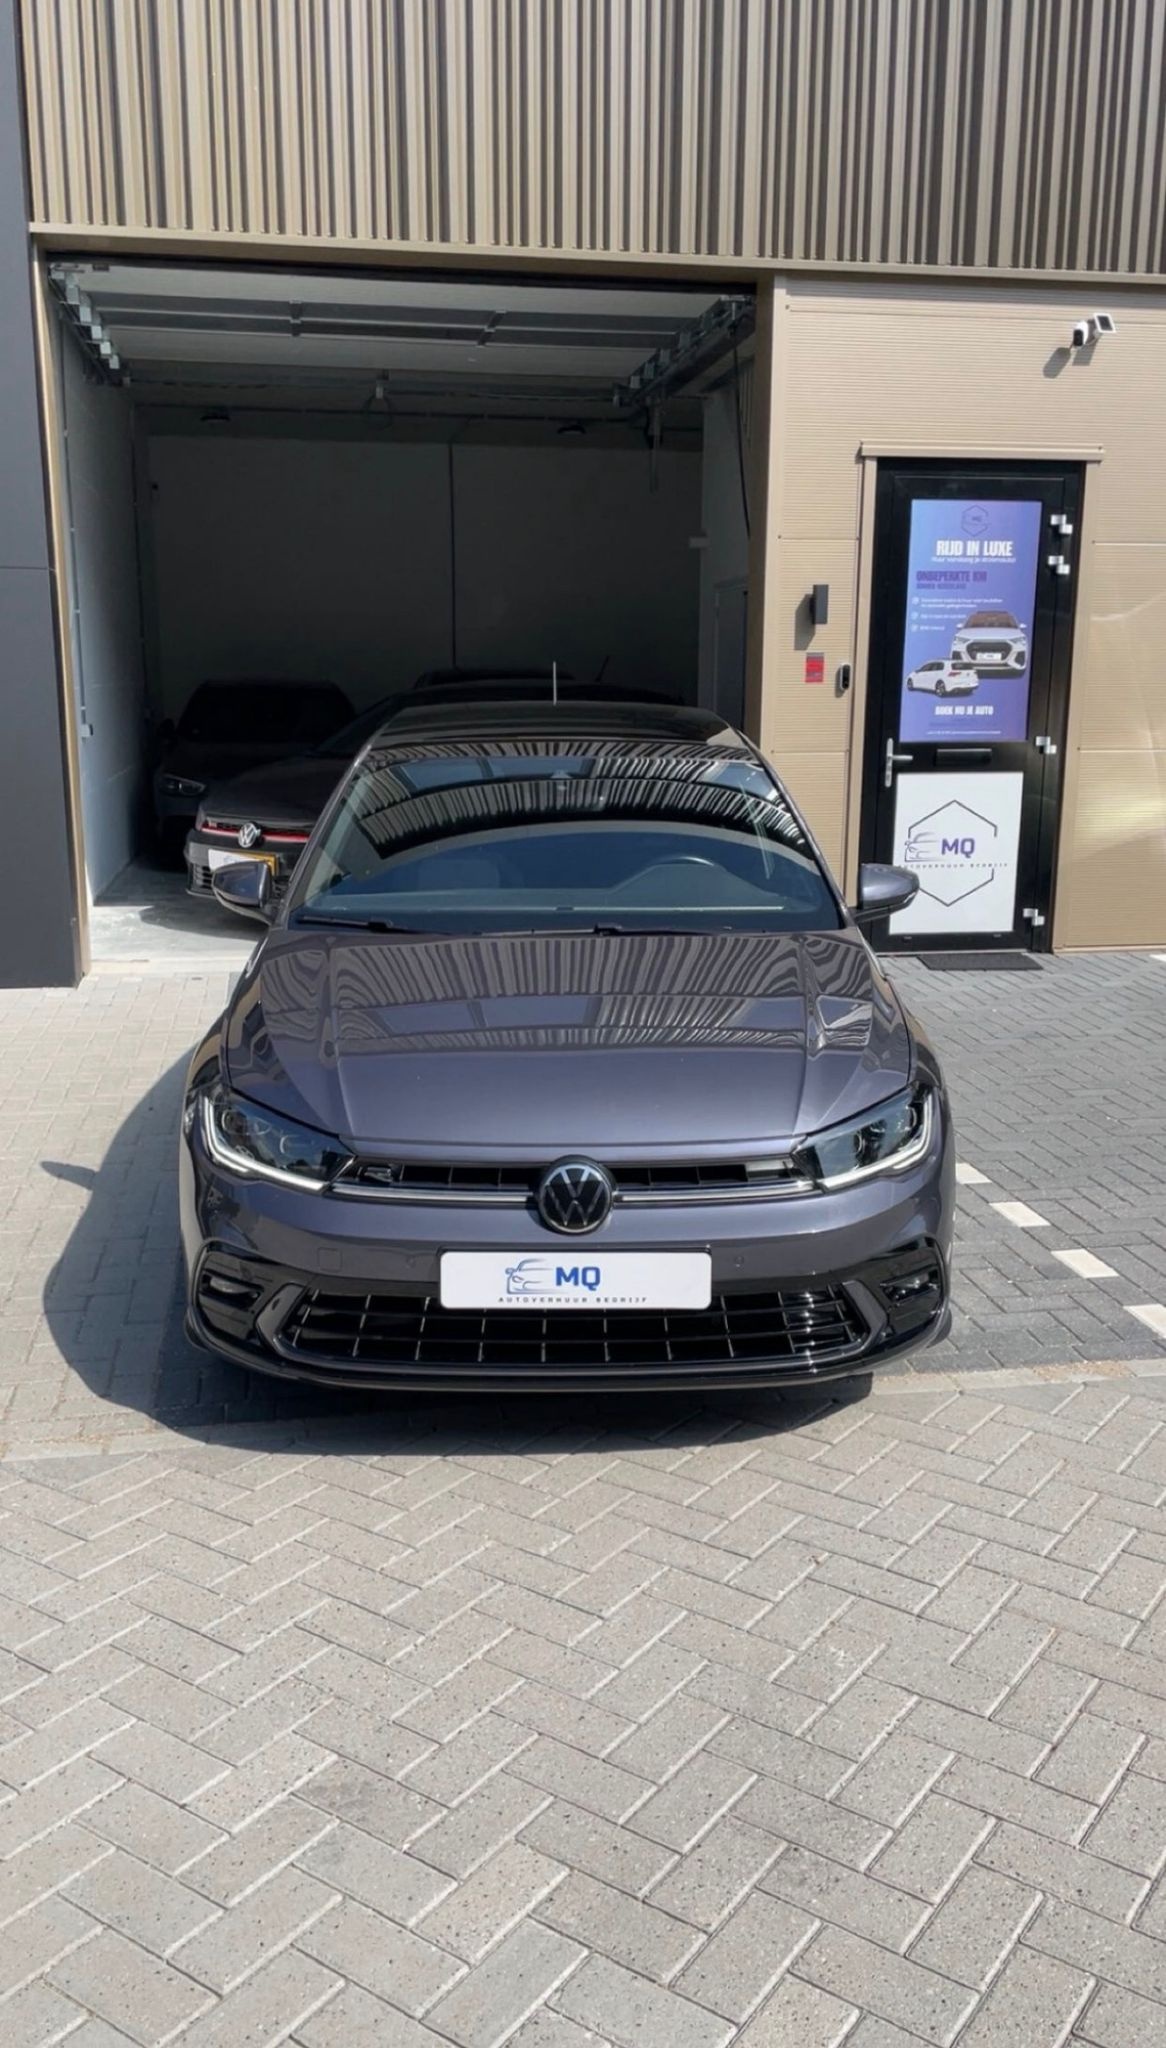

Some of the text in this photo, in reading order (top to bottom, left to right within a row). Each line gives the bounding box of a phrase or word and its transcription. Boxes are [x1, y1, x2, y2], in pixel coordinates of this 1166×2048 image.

[936, 540, 1014, 557] RIJD IN LUXE
[935, 706, 994, 715] BOEK NU JE AUTO
[941, 838, 975, 859] MQ
[556, 1266, 601, 1291] MQ
